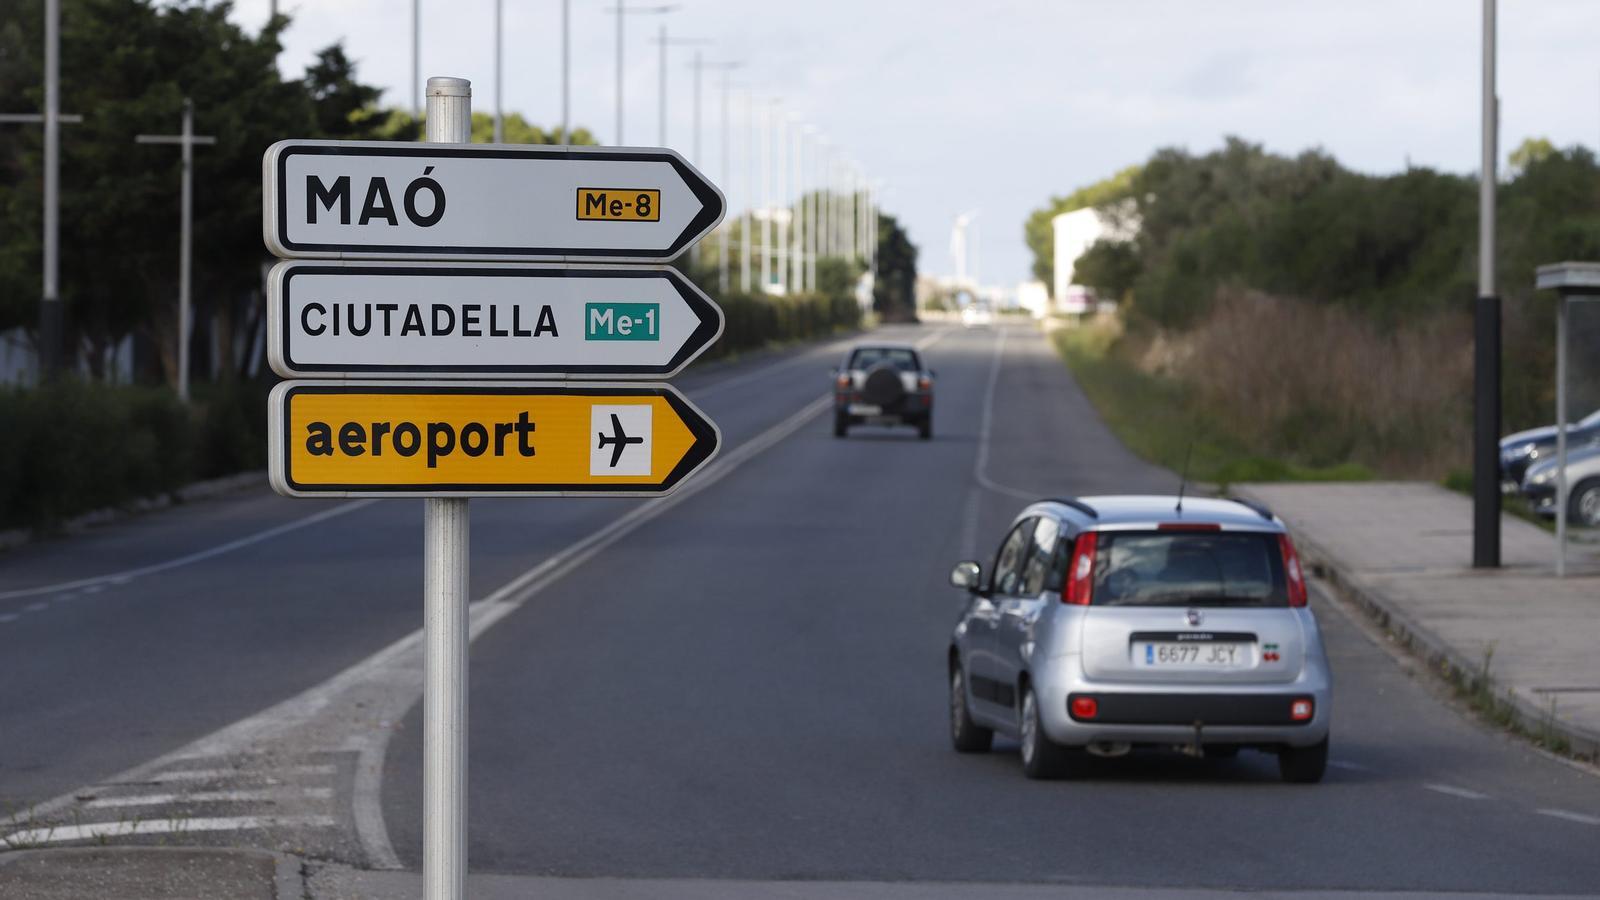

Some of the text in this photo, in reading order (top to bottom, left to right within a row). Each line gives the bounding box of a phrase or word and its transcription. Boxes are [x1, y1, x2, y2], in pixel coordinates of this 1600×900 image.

[305, 166, 447, 228] MAÓ
[584, 193, 652, 217] Me-8
[300, 302, 559, 338] CIUTADELLA
[589, 308, 657, 336] Me-1
[305, 410, 536, 469] aeroport
[1158, 644, 1238, 663] 6677 JCY
